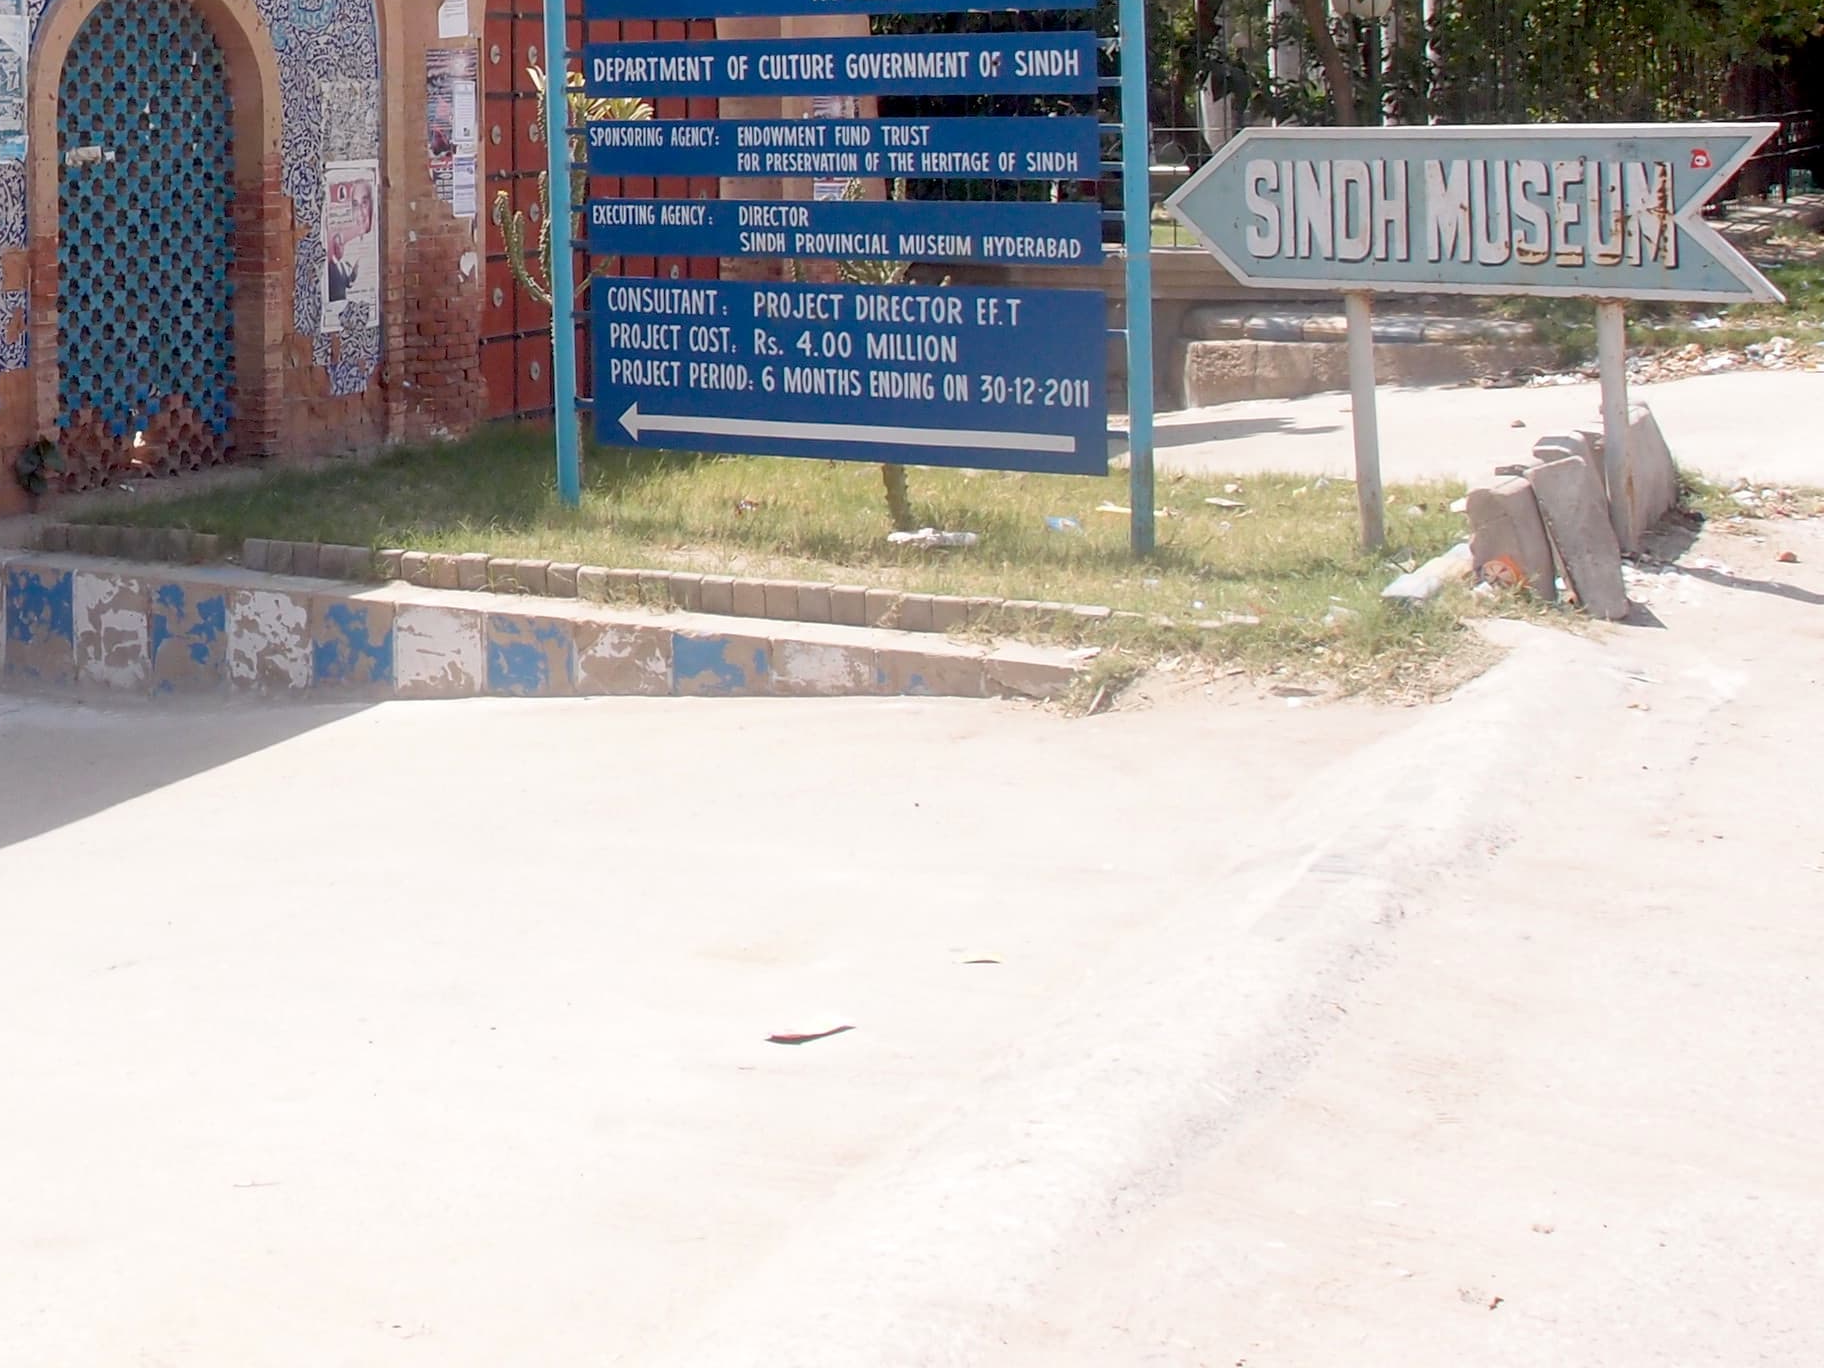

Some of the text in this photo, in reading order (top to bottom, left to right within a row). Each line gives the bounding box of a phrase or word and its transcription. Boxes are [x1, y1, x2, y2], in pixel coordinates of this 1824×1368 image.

[594, 49, 1079, 82] DEPARTMENT OF CULTURE GOVERNMENT OF SINDH
[590, 126, 720, 147] SPONSORING AGENCY:
[737, 125, 931, 147] ENDOWMENT FUND TRUST
[737, 152, 1079, 172] FOR PRESERVATION OF THE HERITAGE OF SINDH
[592, 205, 655, 225] EXECUTING
[739, 206, 809, 227] DIRECTOR
[1244, 158, 1679, 269] SINDH MUSEUM
[740, 232, 1081, 258] SINDH PROVINCIAL MUSEUM HYDERABAD
[754, 291, 843, 320] PROJECT
[855, 294, 963, 325] DIRECTOR
[610, 323, 957, 363] PROJECT COST: Rs. 4.00 MILLION
[611, 359, 1090, 408] PROJECT PERIOD: 6 MONTHS ENDING ON 30-12-2011
